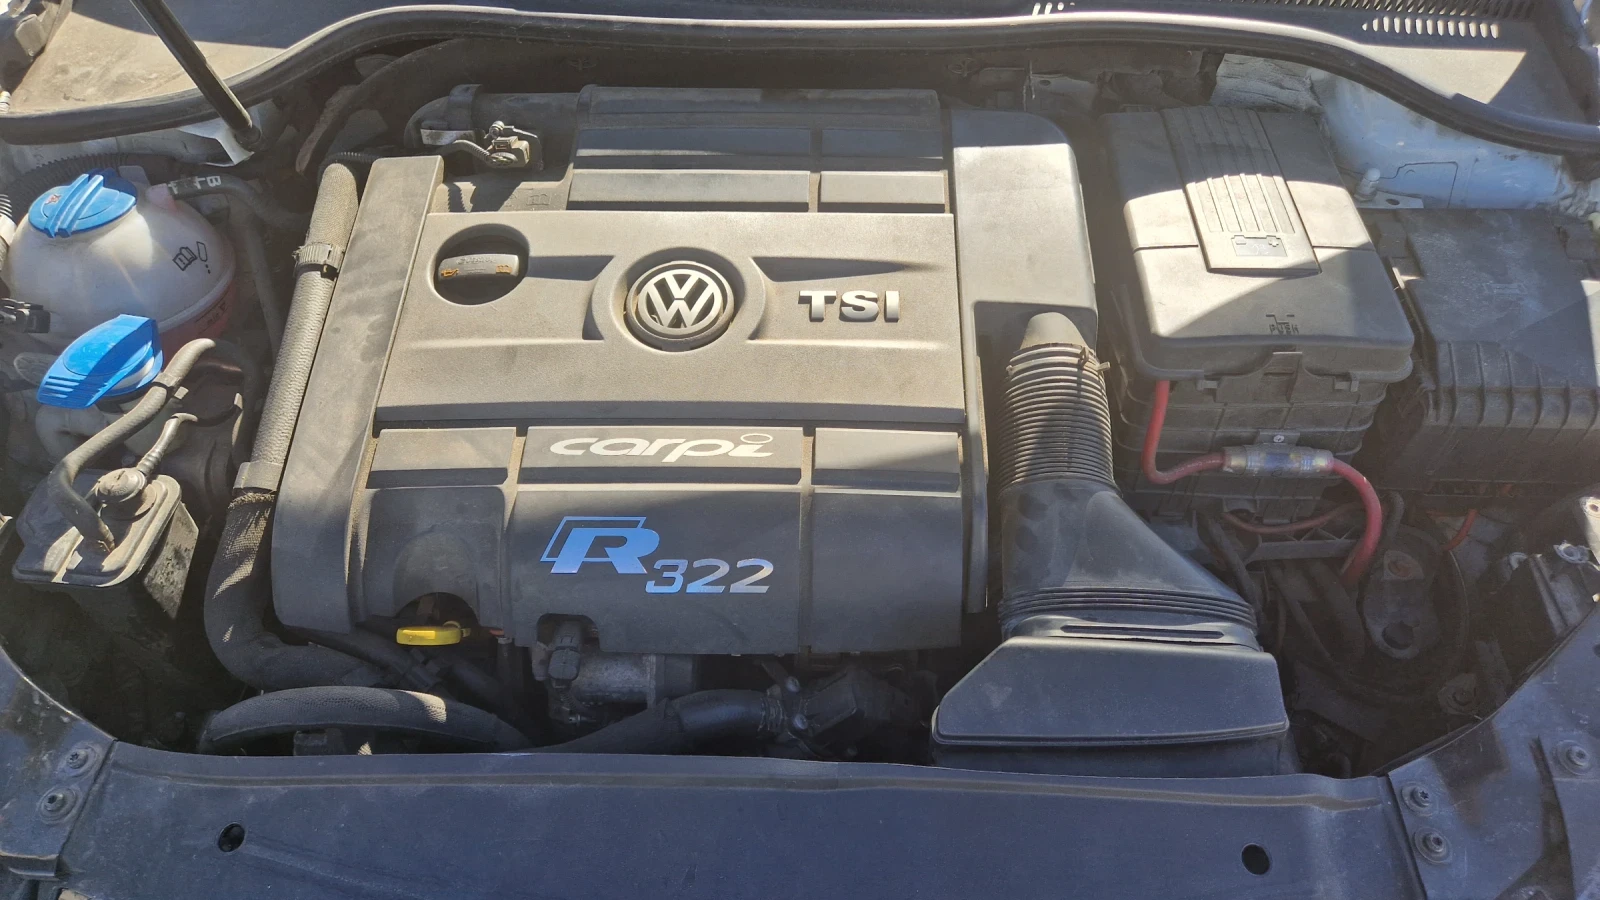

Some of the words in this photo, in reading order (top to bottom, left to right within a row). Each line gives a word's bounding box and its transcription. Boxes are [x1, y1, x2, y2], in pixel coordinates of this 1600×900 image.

[637, 268, 724, 336] VW
[798, 290, 900, 323] TSI
[549, 432, 775, 464] carpi
[540, 516, 661, 575] R
[644, 557, 775, 594] 322
